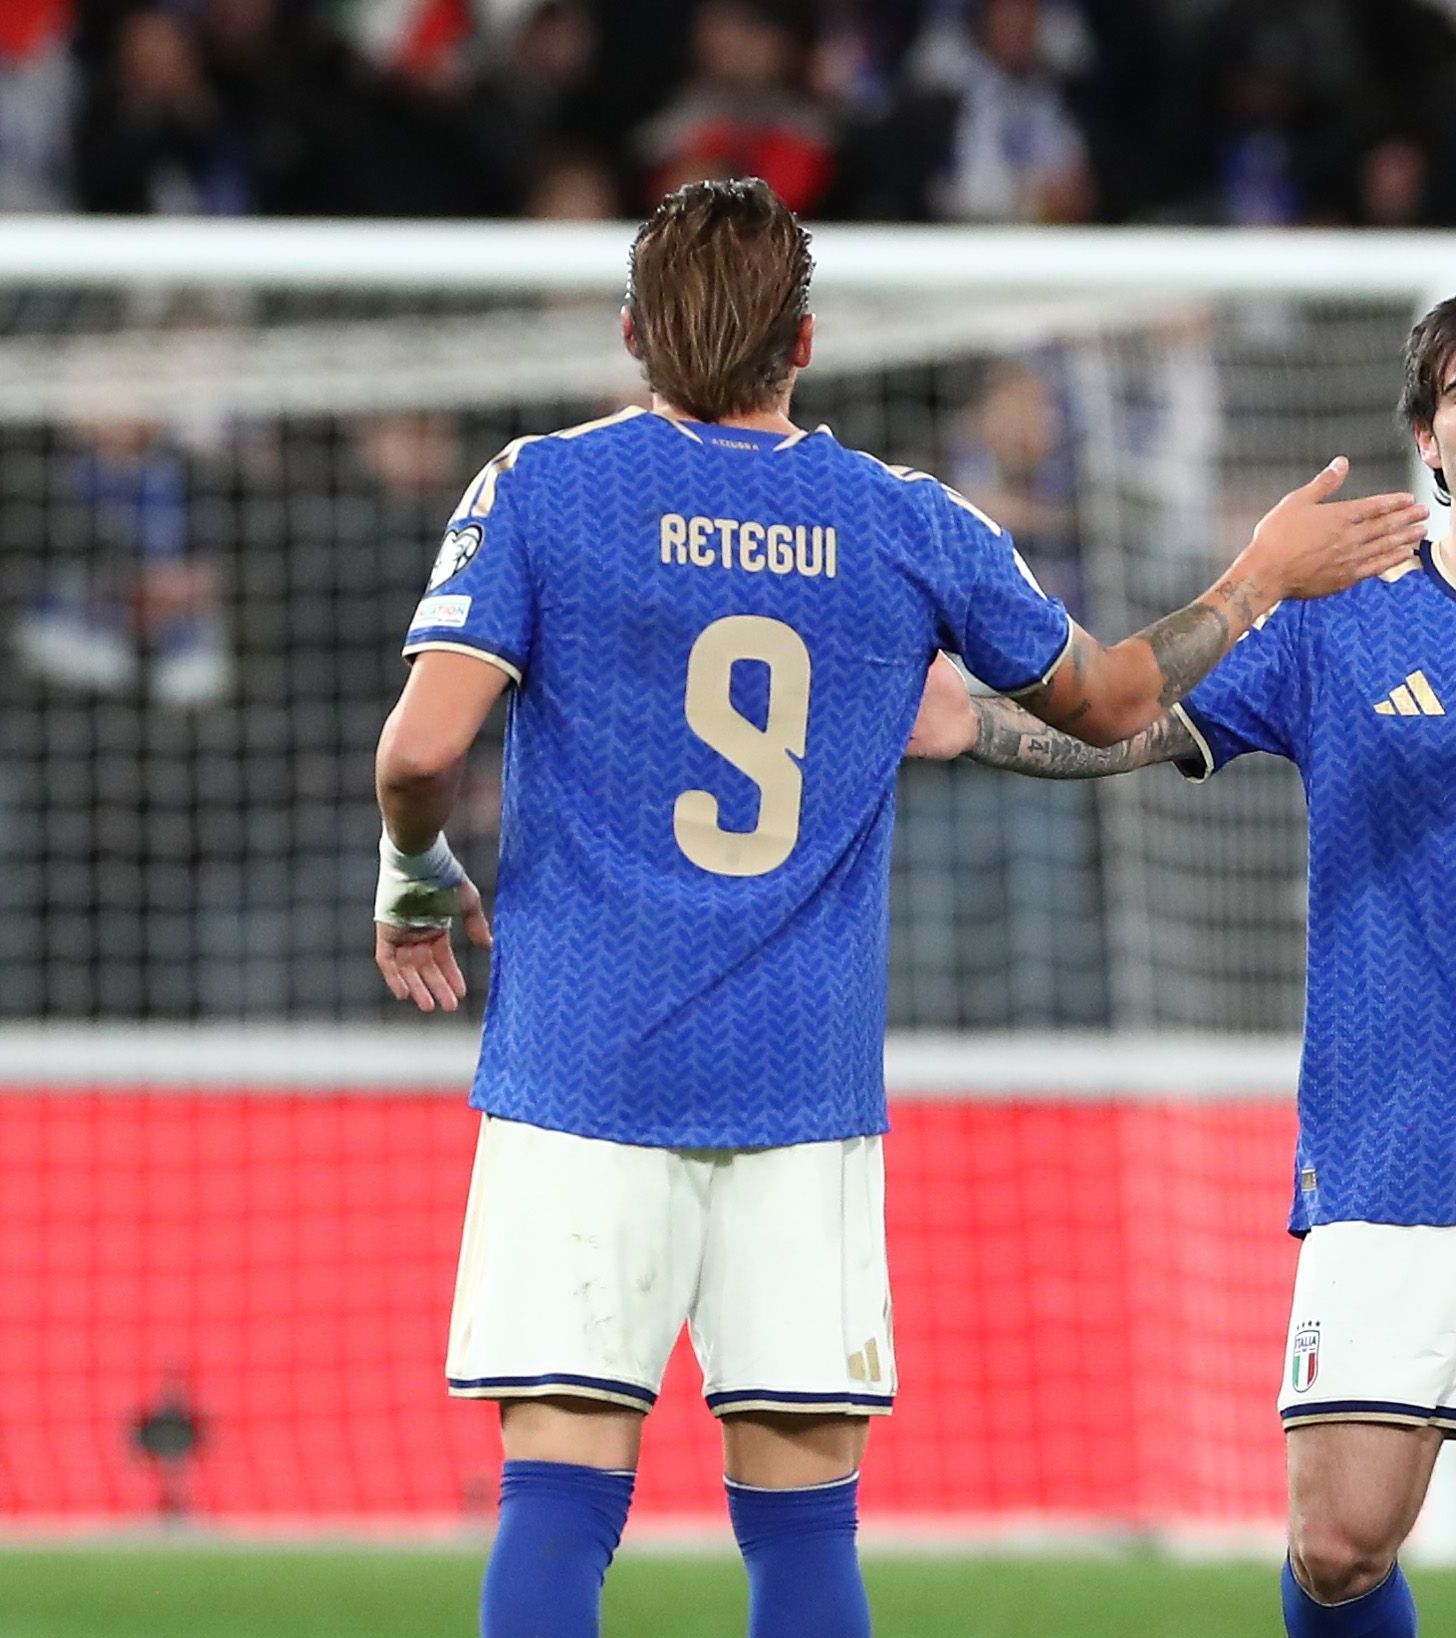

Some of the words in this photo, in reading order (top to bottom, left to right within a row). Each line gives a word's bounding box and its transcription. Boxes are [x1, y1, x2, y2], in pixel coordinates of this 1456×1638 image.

[660, 513, 836, 578] RETEGUI
[673, 615, 811, 877] 9
[1294, 1335, 1317, 1349] ITALIA
